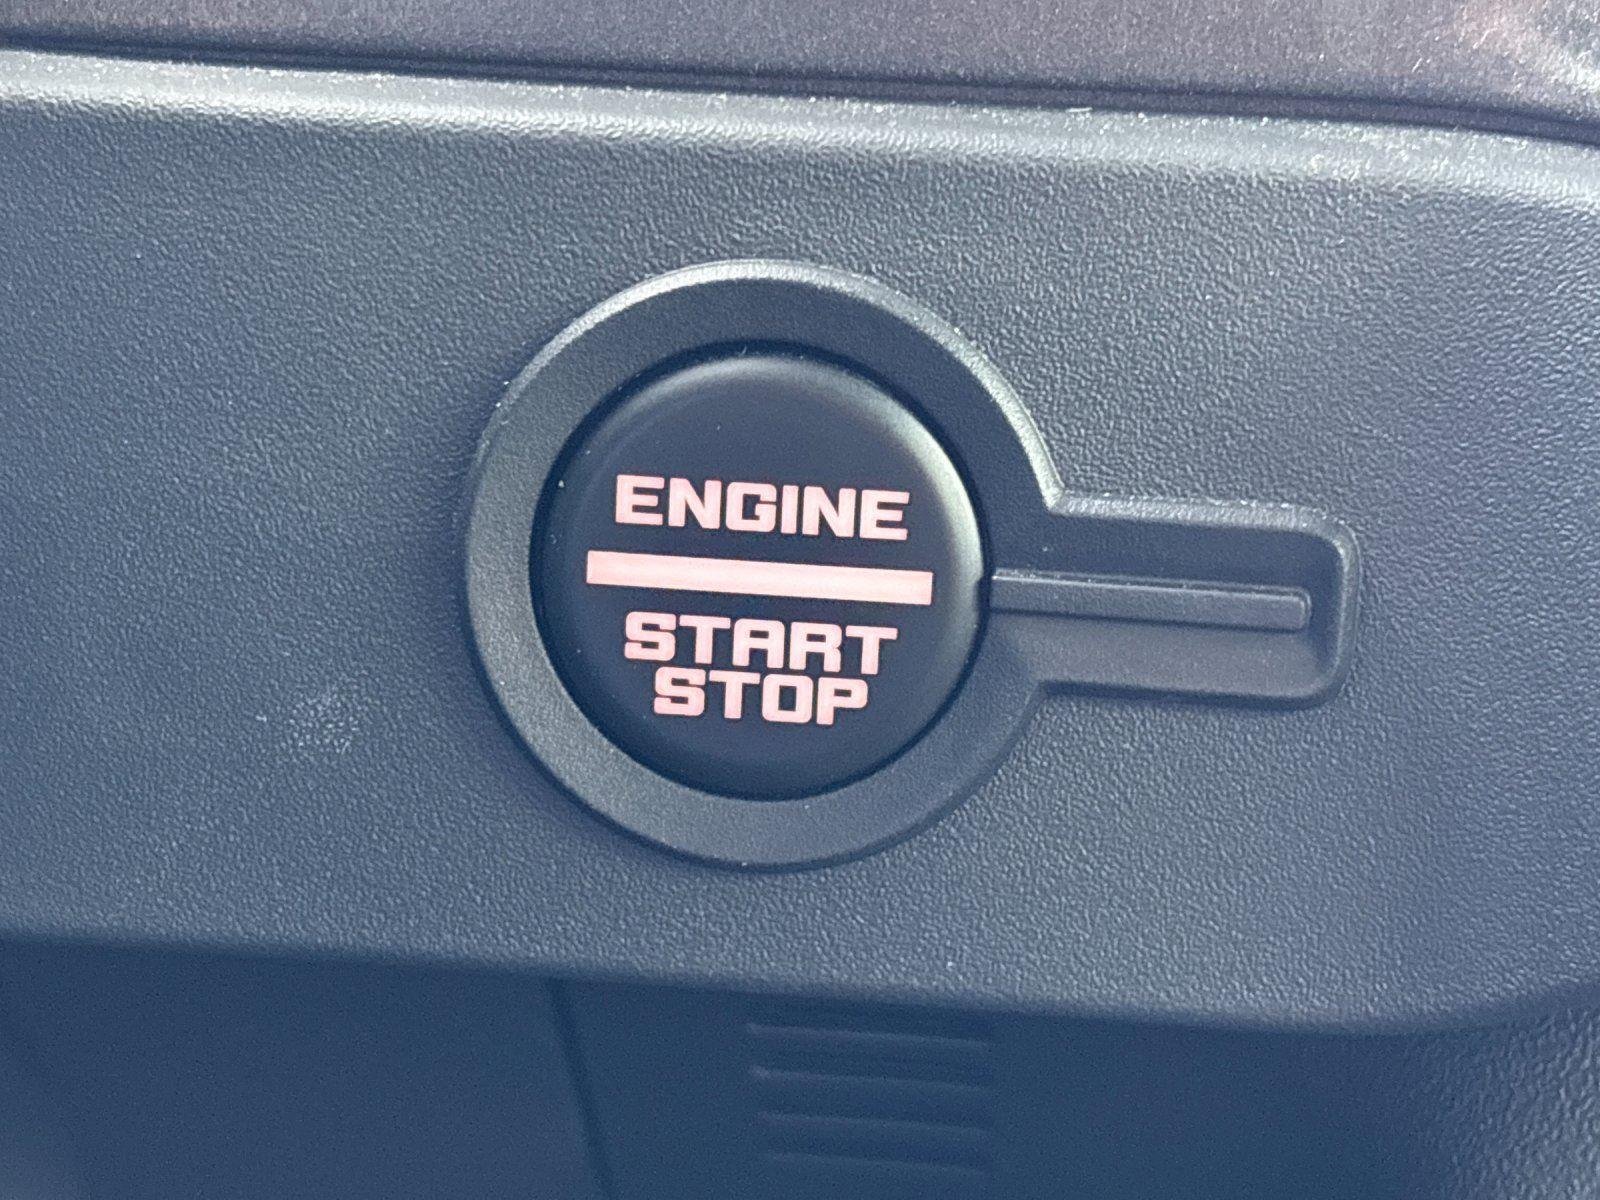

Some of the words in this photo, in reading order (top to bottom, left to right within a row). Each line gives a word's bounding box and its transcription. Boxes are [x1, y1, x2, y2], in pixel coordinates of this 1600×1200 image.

[615, 474, 910, 541] ENGINE
[624, 611, 899, 675] START
[653, 666, 869, 726] STOP
